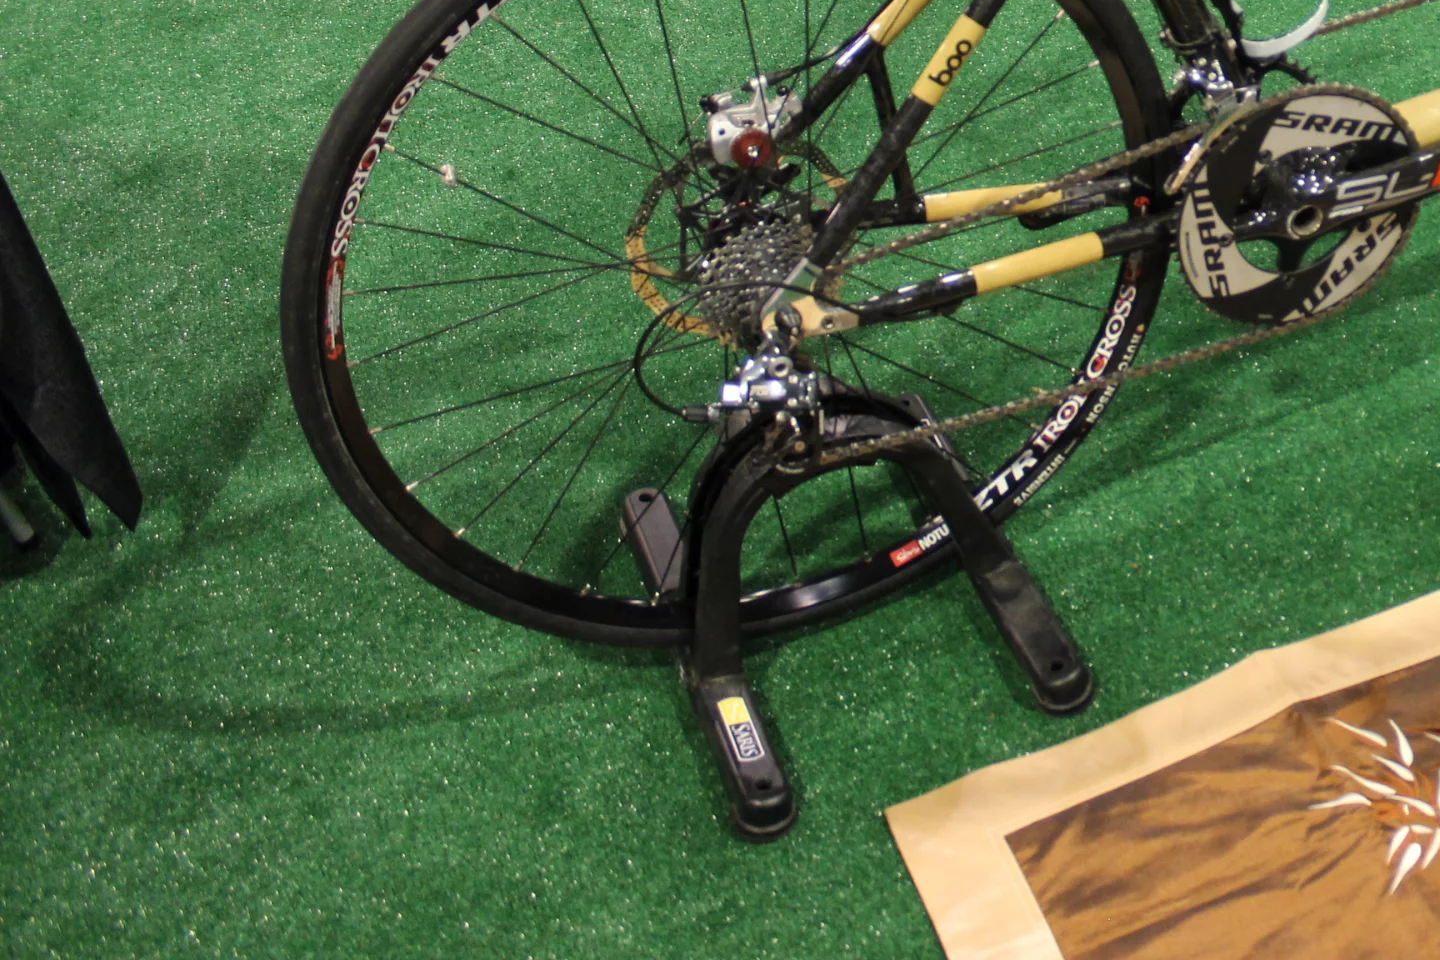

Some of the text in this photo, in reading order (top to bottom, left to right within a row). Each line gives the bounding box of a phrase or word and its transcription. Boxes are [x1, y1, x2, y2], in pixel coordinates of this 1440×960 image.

[928, 40, 972, 87] boo
[1273, 111, 1397, 141] SRAM
[331, 142, 381, 258] CROSS
[918, 523, 949, 551] NOTU
[973, 449, 1038, 511] ZTR
[1086, 284, 1137, 381] CROSS
[1013, 453, 1066, 507] INTENSIVE
[731, 724, 759, 757] SARIS
